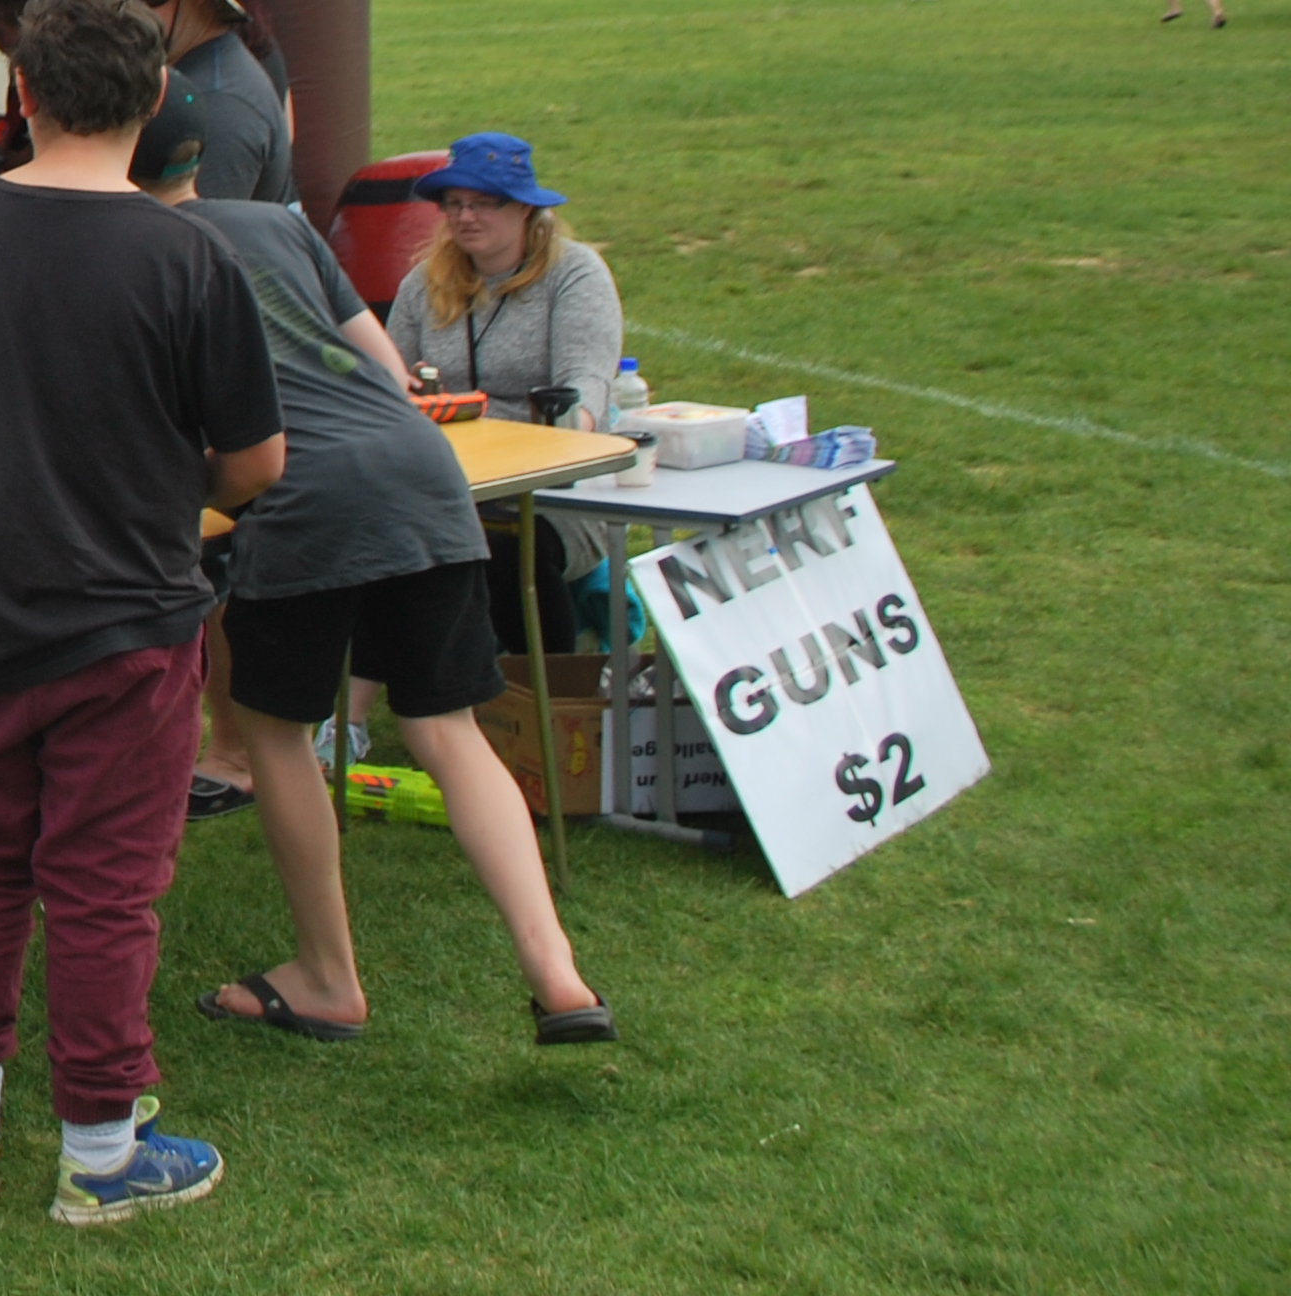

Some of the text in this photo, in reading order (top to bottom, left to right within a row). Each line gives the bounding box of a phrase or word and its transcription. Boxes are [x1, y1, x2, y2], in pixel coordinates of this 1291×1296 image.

[657, 486, 858, 621] NERF
[714, 593, 921, 736] GUNS
[834, 732, 926, 828] $2
